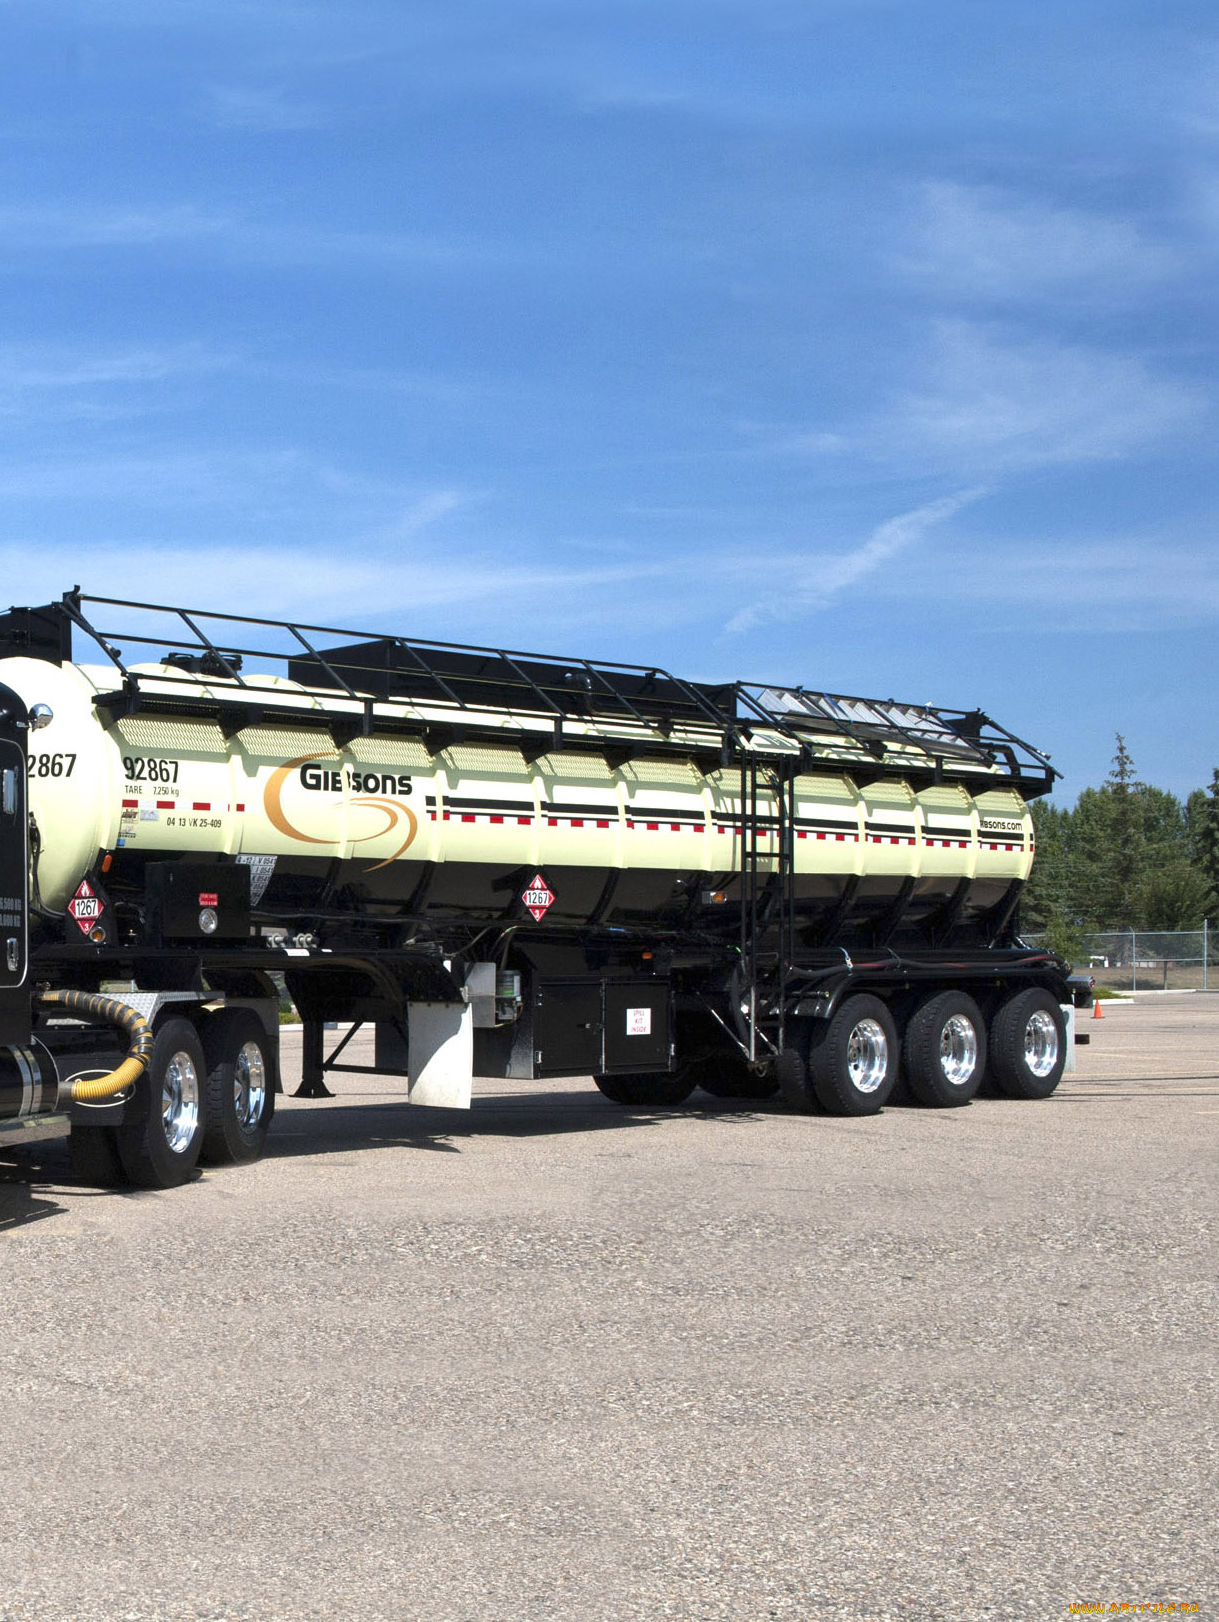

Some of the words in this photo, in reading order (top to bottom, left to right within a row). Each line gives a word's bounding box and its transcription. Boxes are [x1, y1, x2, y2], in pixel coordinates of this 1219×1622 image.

[28, 754, 77, 778] 2867
[123, 756, 179, 783] 92867
[125, 785, 143, 794] TARE
[171, 787, 179, 797] kg
[166, 817, 176, 826] 04
[178, 817, 186, 827] 13
[199, 818, 222, 828] 25-409
[528, 892, 548, 904] 1267
[77, 900, 97, 916] 1267
[535, 910, 540, 919] 3
[84, 923, 89, 931] 3
